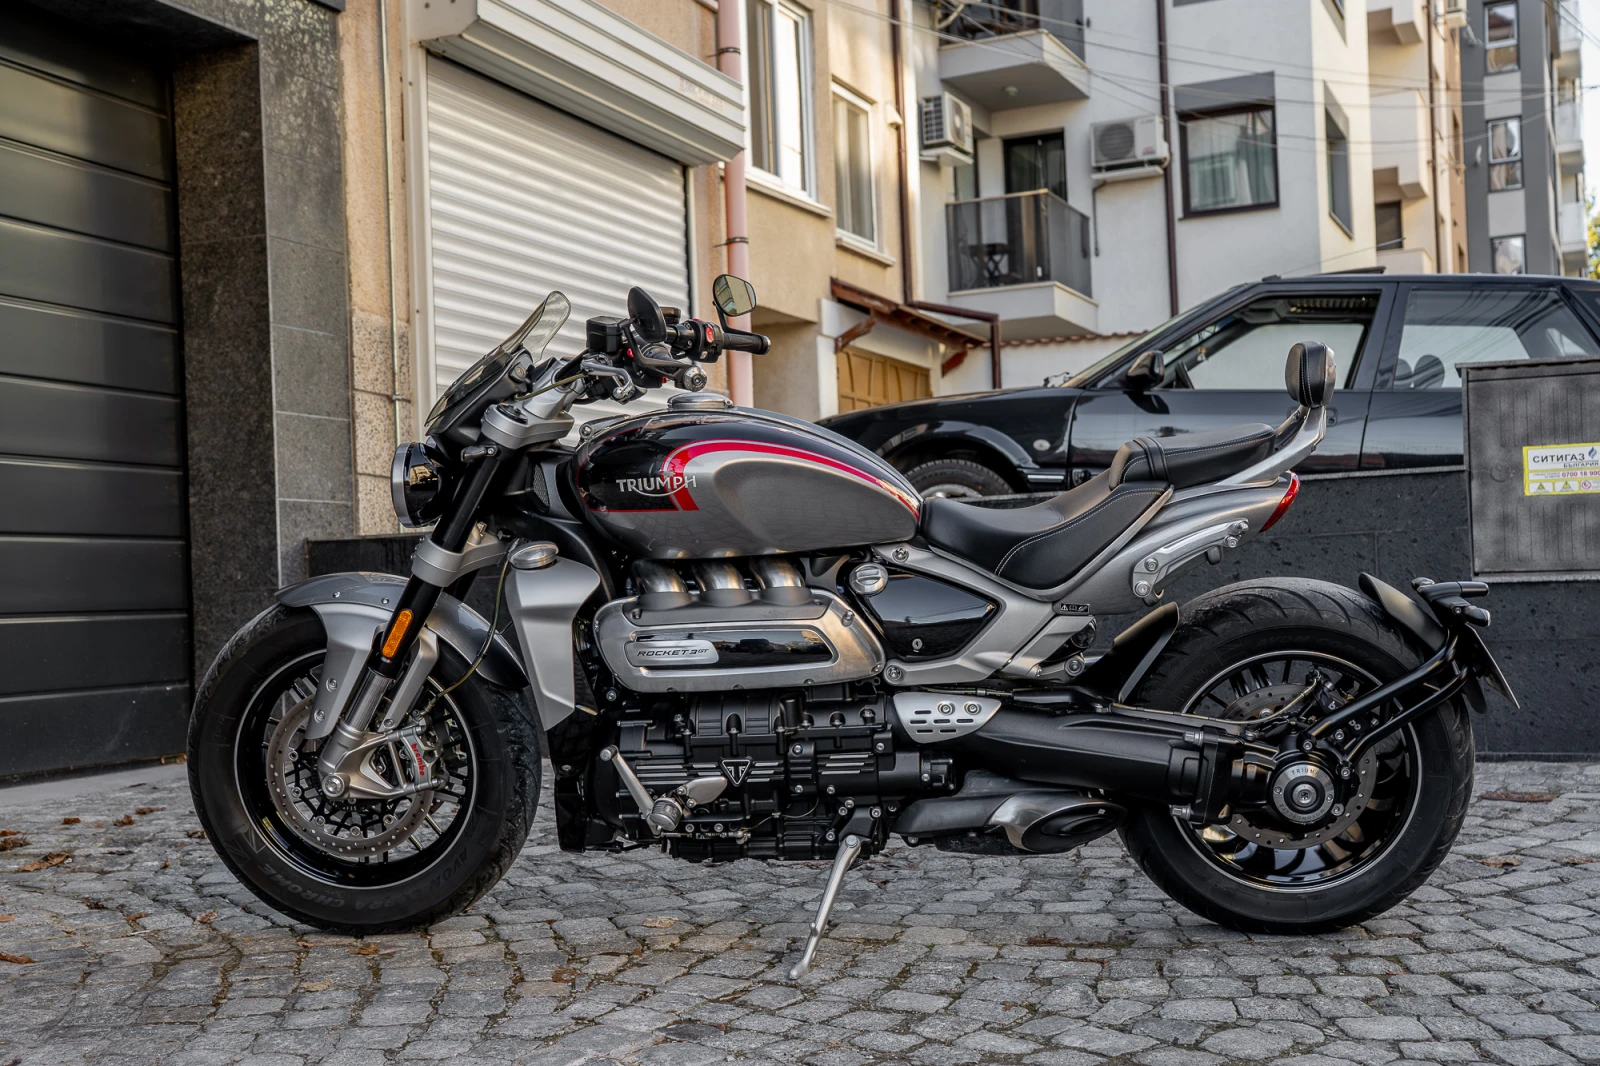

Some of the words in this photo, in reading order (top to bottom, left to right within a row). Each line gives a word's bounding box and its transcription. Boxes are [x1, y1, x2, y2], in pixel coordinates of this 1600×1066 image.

[1532, 453, 1586, 464] СИТИГАЗ
[616, 475, 697, 496] TRIUMPH
[411, 743, 426, 776] brembo
[257, 863, 345, 908] CHROME
